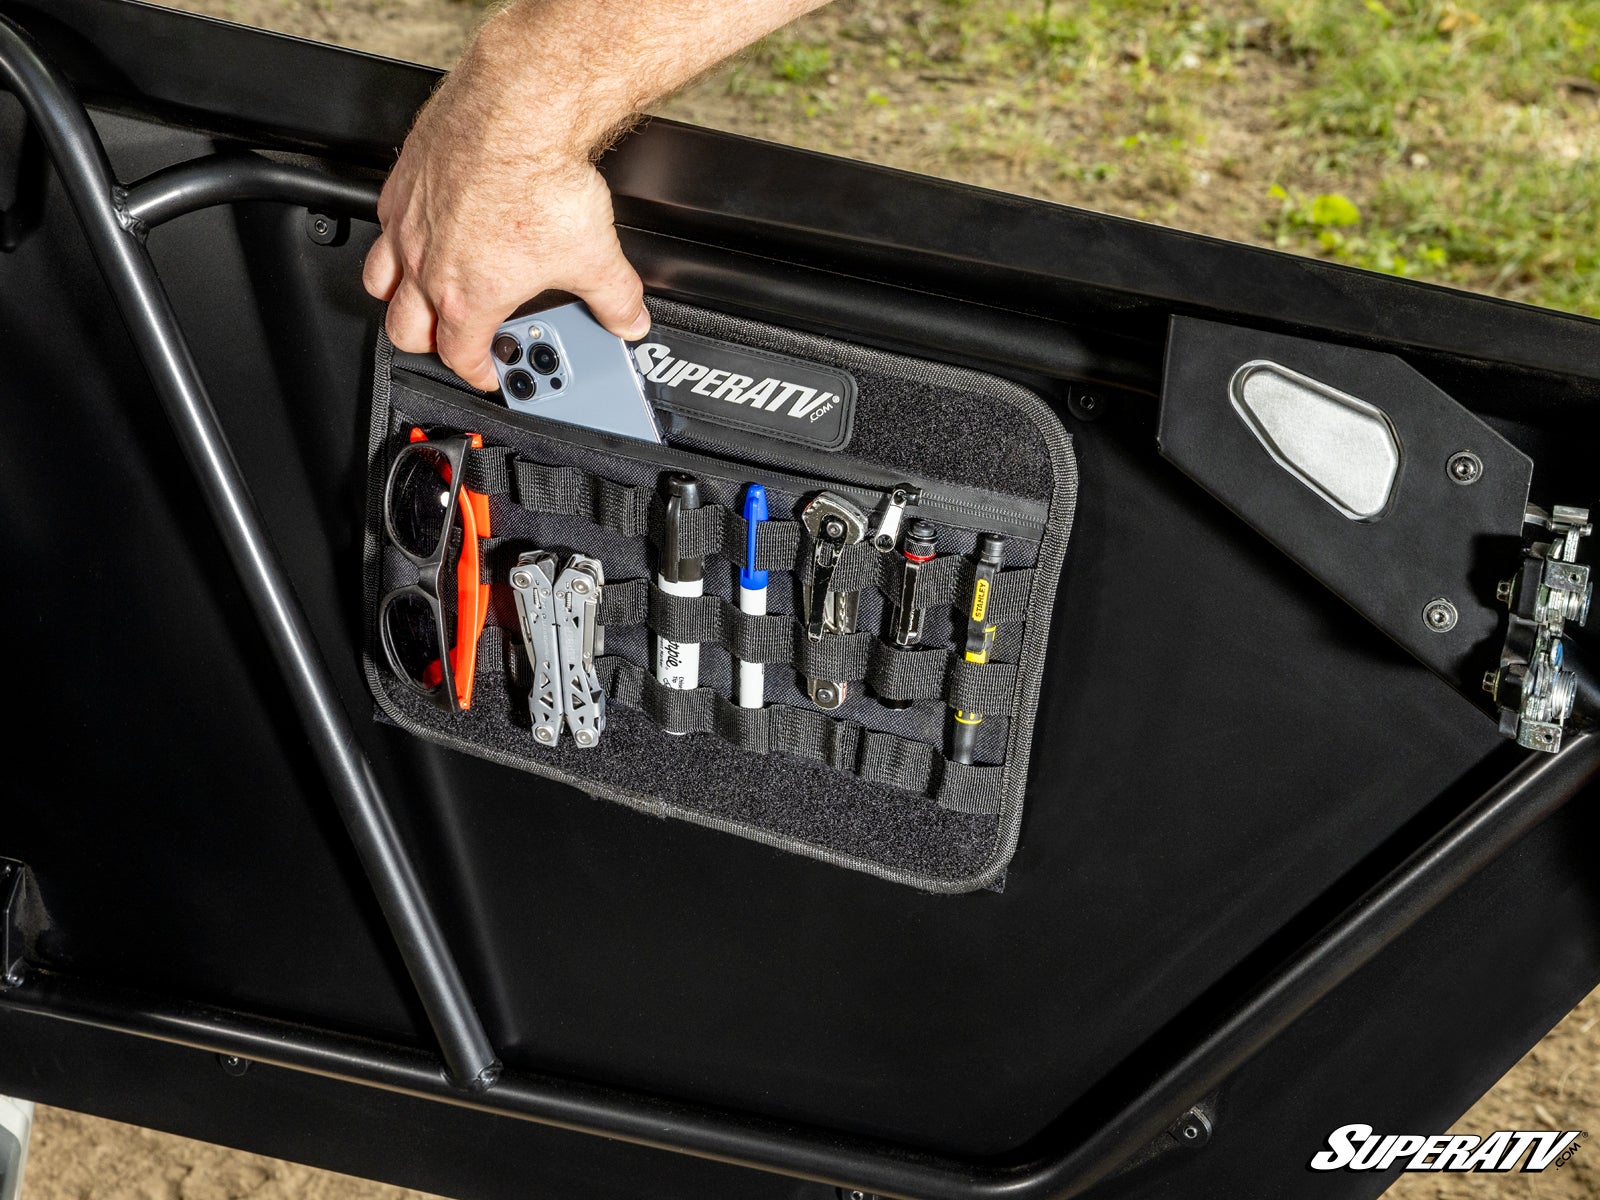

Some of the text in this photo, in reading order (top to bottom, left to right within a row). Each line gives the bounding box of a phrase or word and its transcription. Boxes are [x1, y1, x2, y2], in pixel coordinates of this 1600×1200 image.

[634, 343, 833, 418] SUPERATV
[975, 582, 986, 617] STANLEY
[665, 641, 682, 668] rpie
